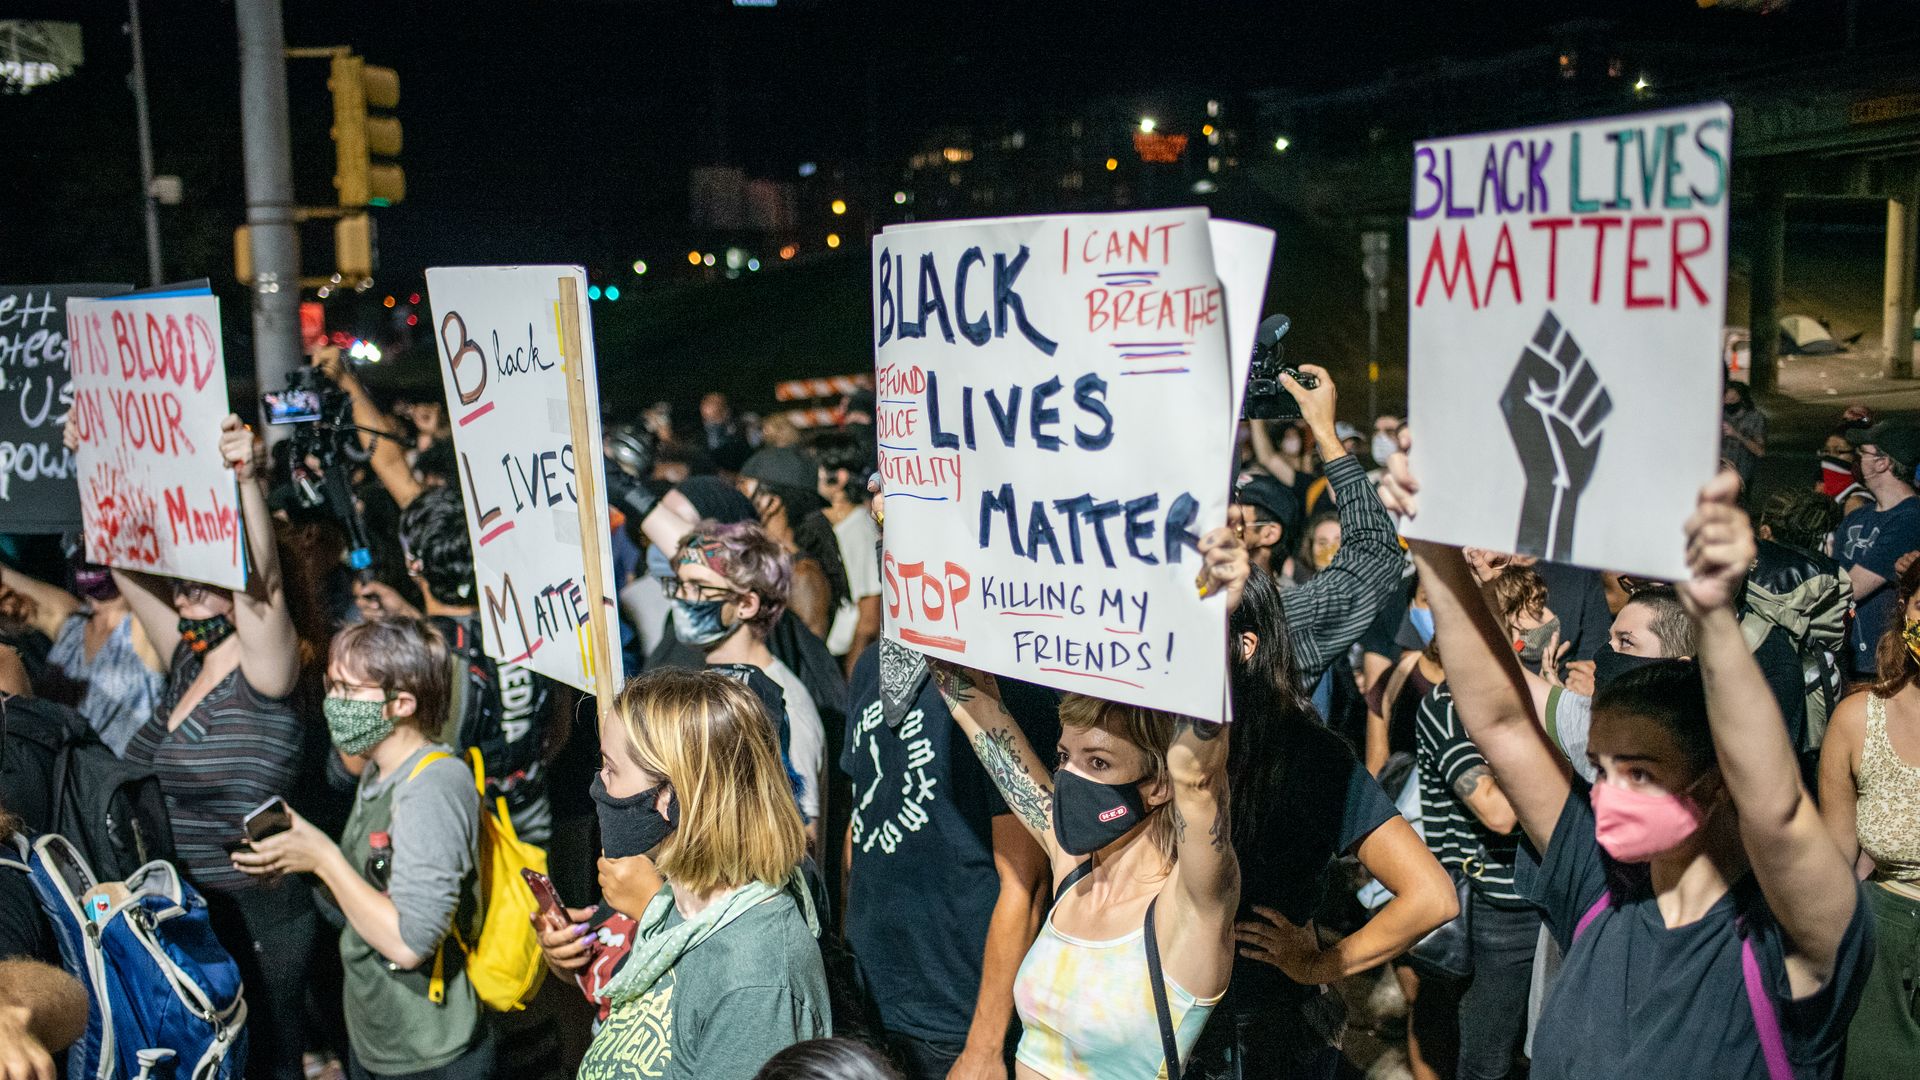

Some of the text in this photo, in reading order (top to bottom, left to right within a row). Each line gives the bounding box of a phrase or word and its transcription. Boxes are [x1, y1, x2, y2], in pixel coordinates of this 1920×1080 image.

[1415, 118, 1728, 219] BLACK LIVES
[1062, 222, 1186, 275] I CANT
[1415, 217, 1712, 311] MATTER
[878, 244, 1059, 357] BLACK
[1084, 284, 1223, 336] BREATHE
[66, 309, 216, 393] HIS BLOOD
[440, 310, 555, 406] Black
[876, 362, 927, 399] EFUND
[75, 386, 196, 457] ON YOUR
[876, 405, 919, 440] OLICE
[926, 370, 1115, 453] LIVES
[460, 444, 579, 531] LIVES
[978, 483, 1201, 569] MATTER
[485, 572, 614, 661] MATTE
[883, 550, 971, 632] STOP
[981, 575, 1149, 632] KILLING MY
